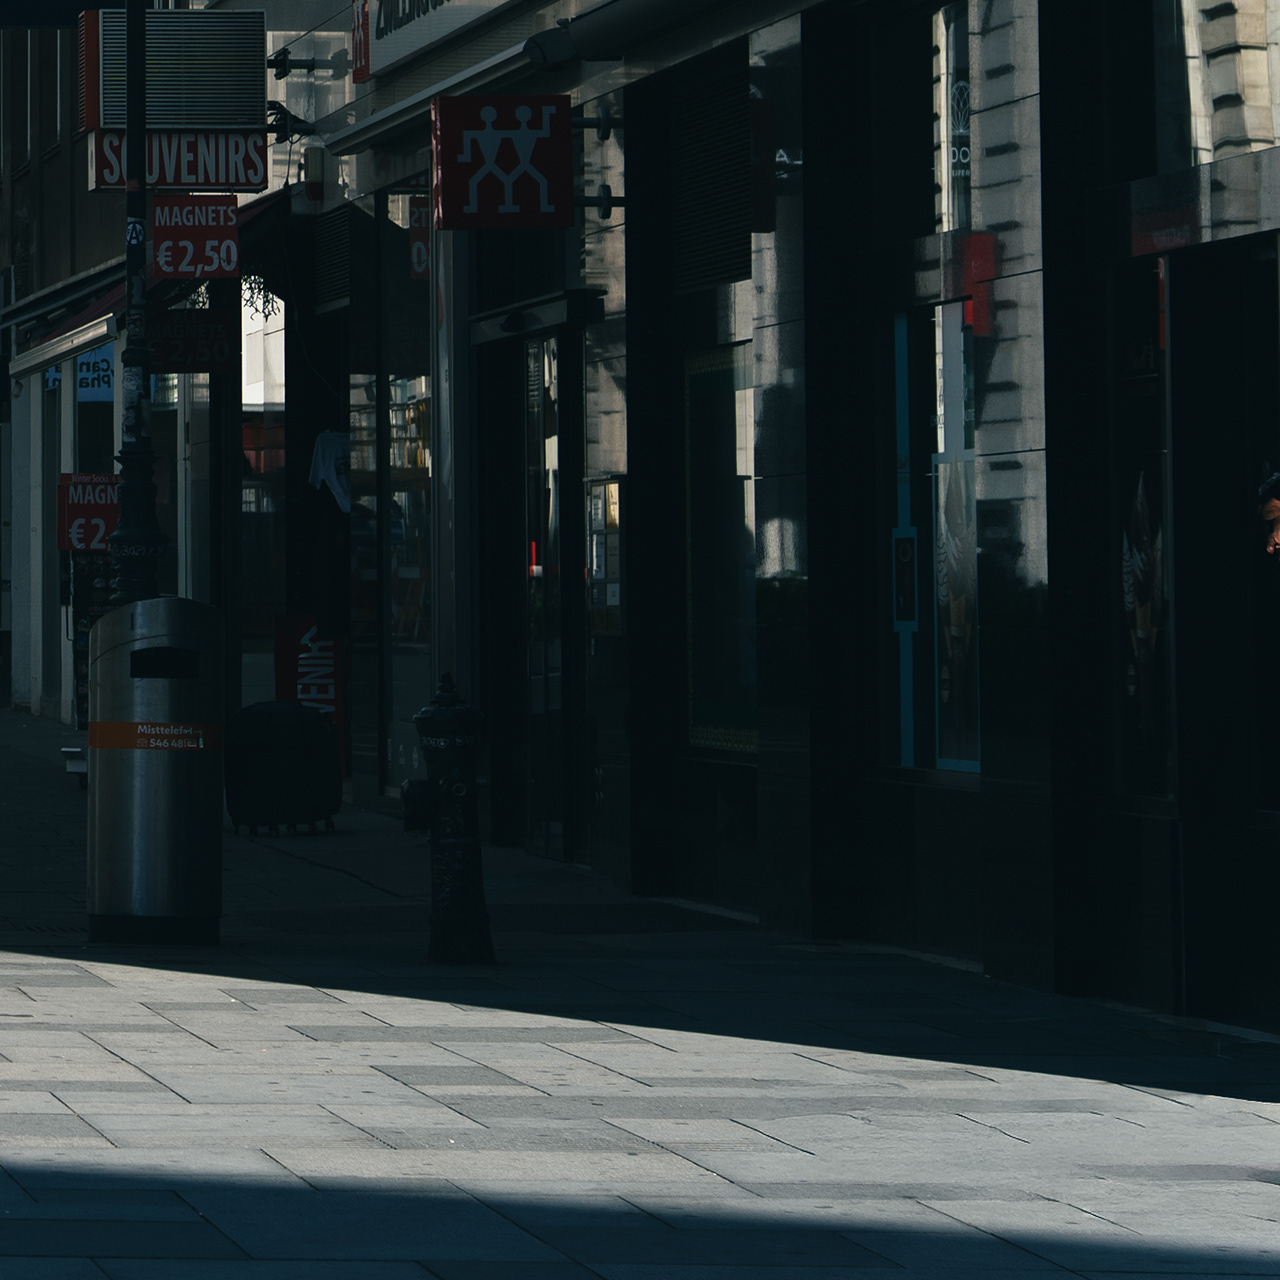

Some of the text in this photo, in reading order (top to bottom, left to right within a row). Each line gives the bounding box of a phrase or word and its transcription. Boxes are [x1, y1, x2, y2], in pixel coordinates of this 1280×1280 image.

[101, 131, 265, 185] SUVENIRS
[154, 205, 238, 228] MAGNETS
[155, 238, 238, 278] € 2,50
[71, 474, 91, 483] Winter
[92, 474, 110, 484] Socks
[68, 484, 119, 505] MAGN
[68, 517, 86, 550] €
[149, 738, 170, 748] 546
